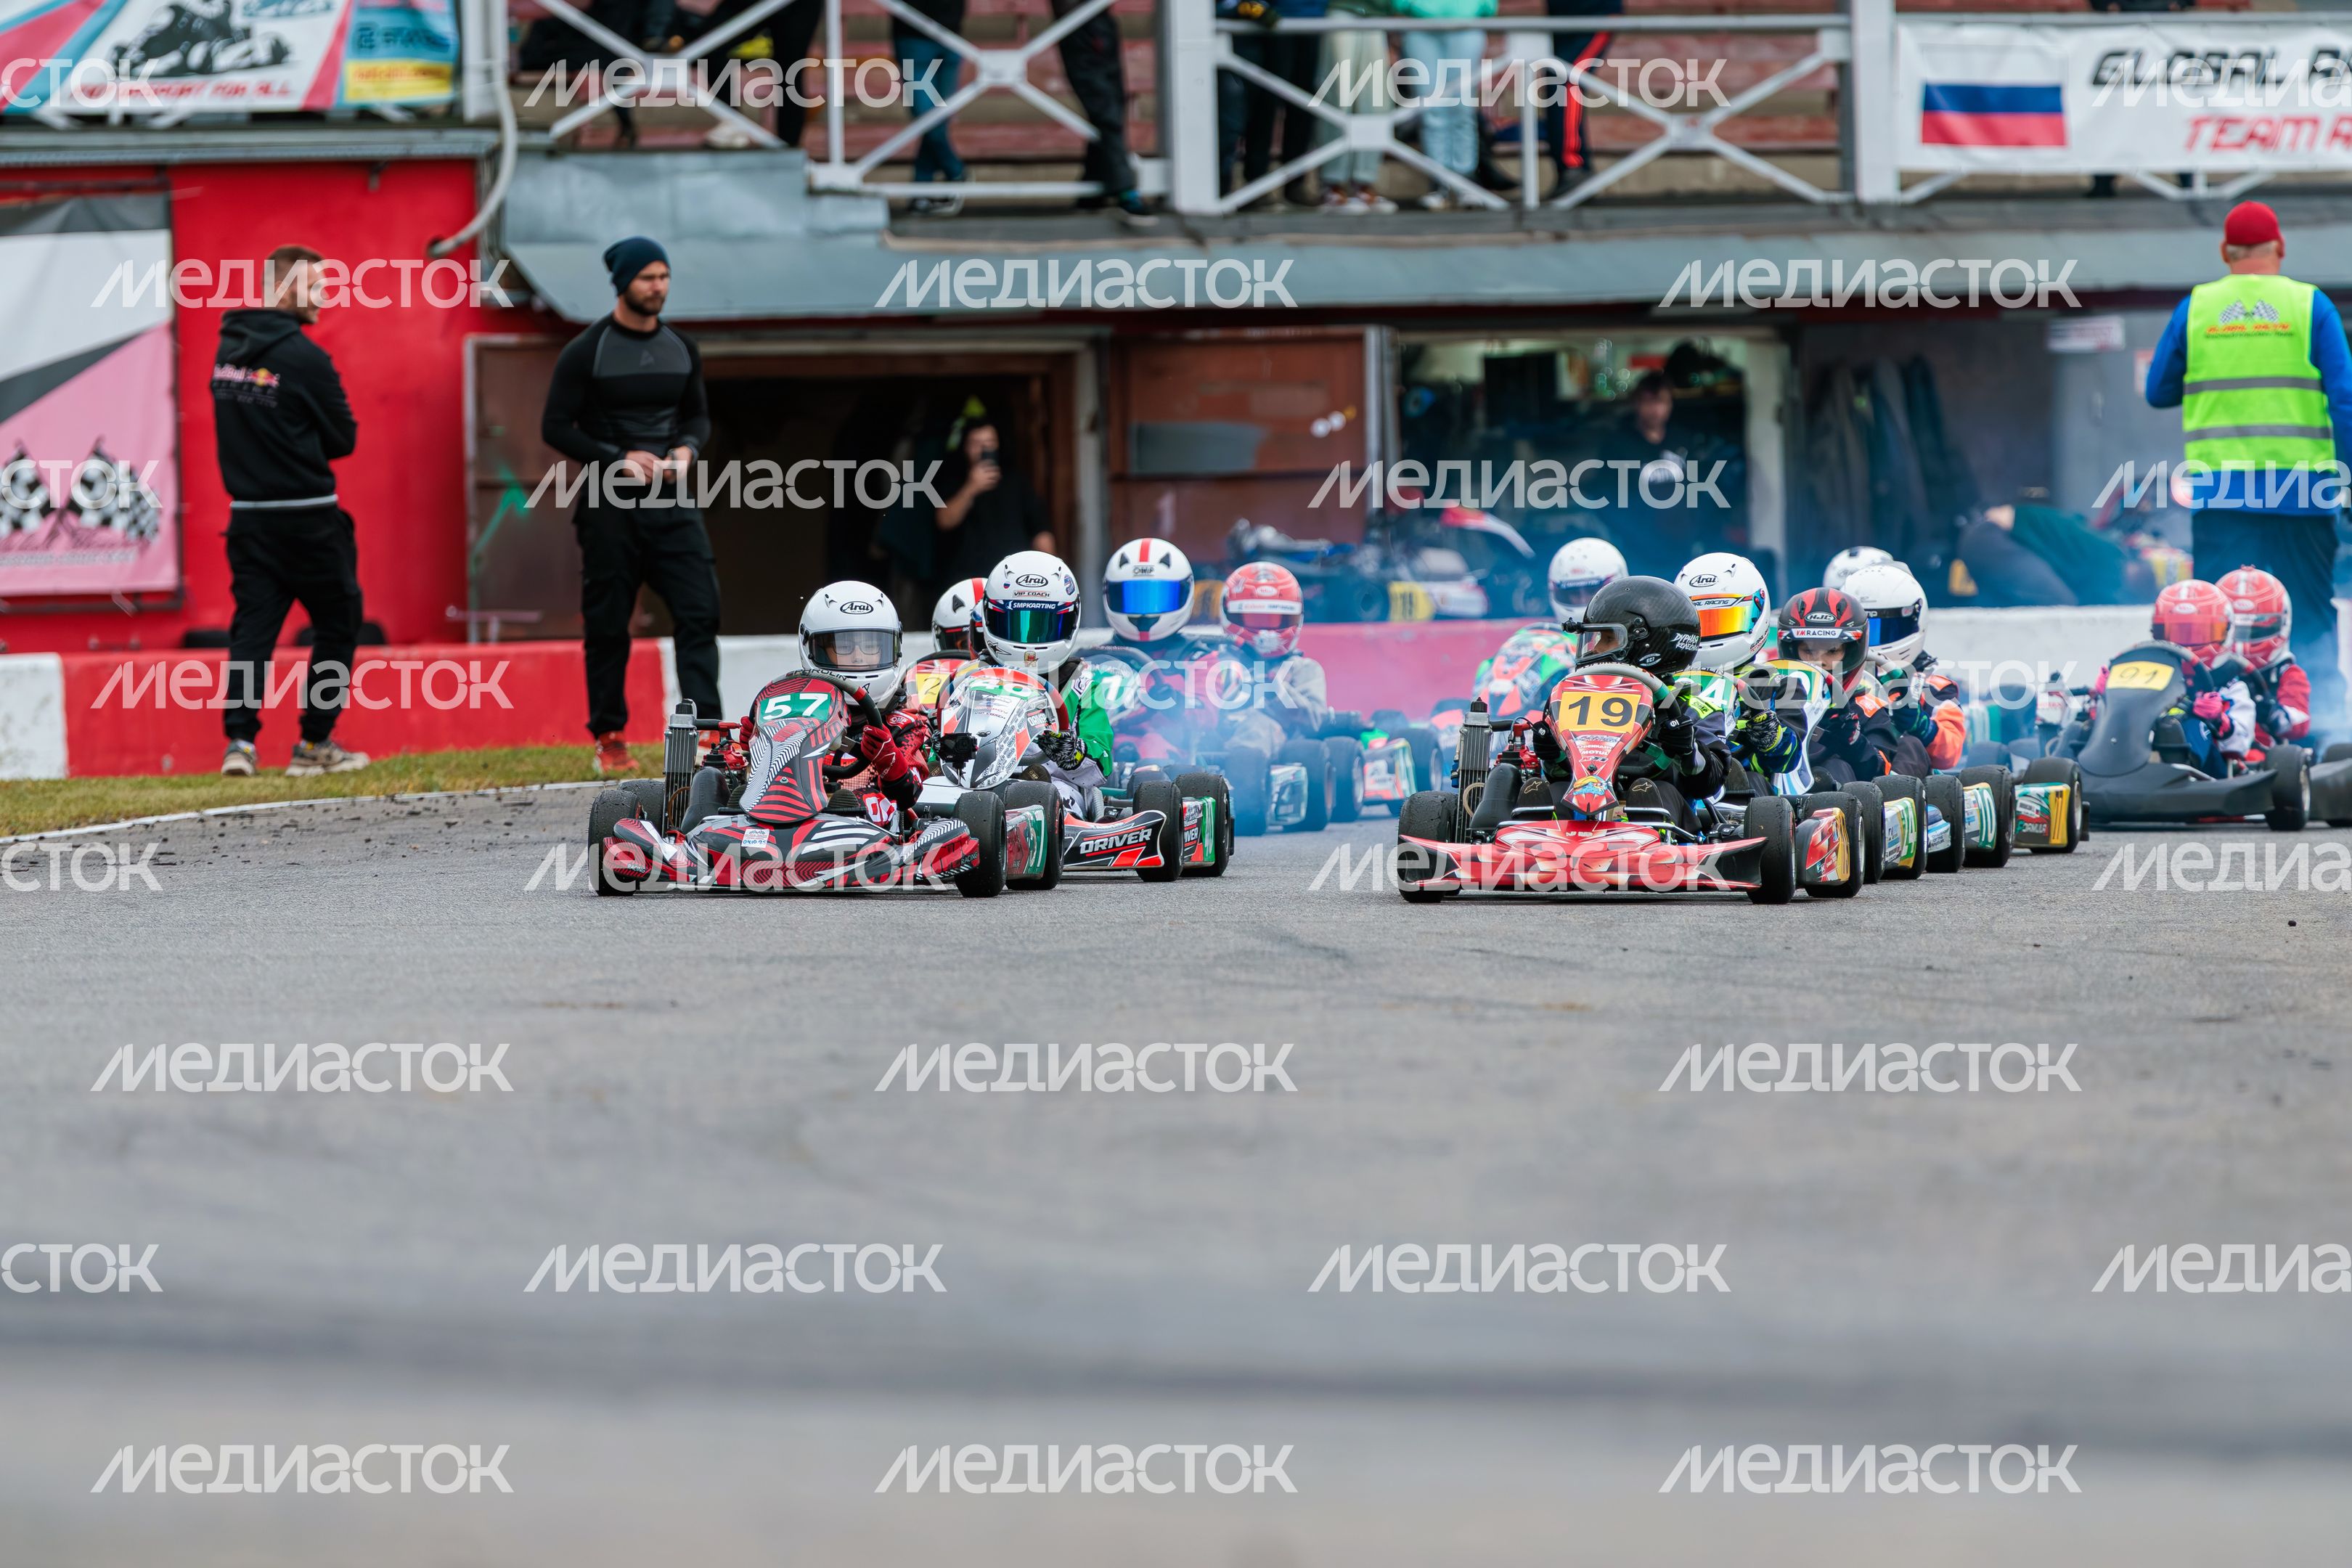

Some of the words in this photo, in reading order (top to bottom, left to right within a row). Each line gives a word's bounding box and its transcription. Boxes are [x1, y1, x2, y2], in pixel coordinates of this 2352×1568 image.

[2186, 114, 2322, 152] TEAM
[1017, 575, 1045, 584] Arai
[1692, 574, 1717, 584] Arai
[844, 602, 870, 612] Arai
[762, 693, 828, 720] 57
[1568, 695, 1633, 727] 19
[1974, 788, 1996, 843] 10
[1079, 828, 1152, 854] DRIVER
[1184, 828, 1199, 843] IVER
[960, 852, 979, 865] RACING
[626, 863, 645, 873] RACING
